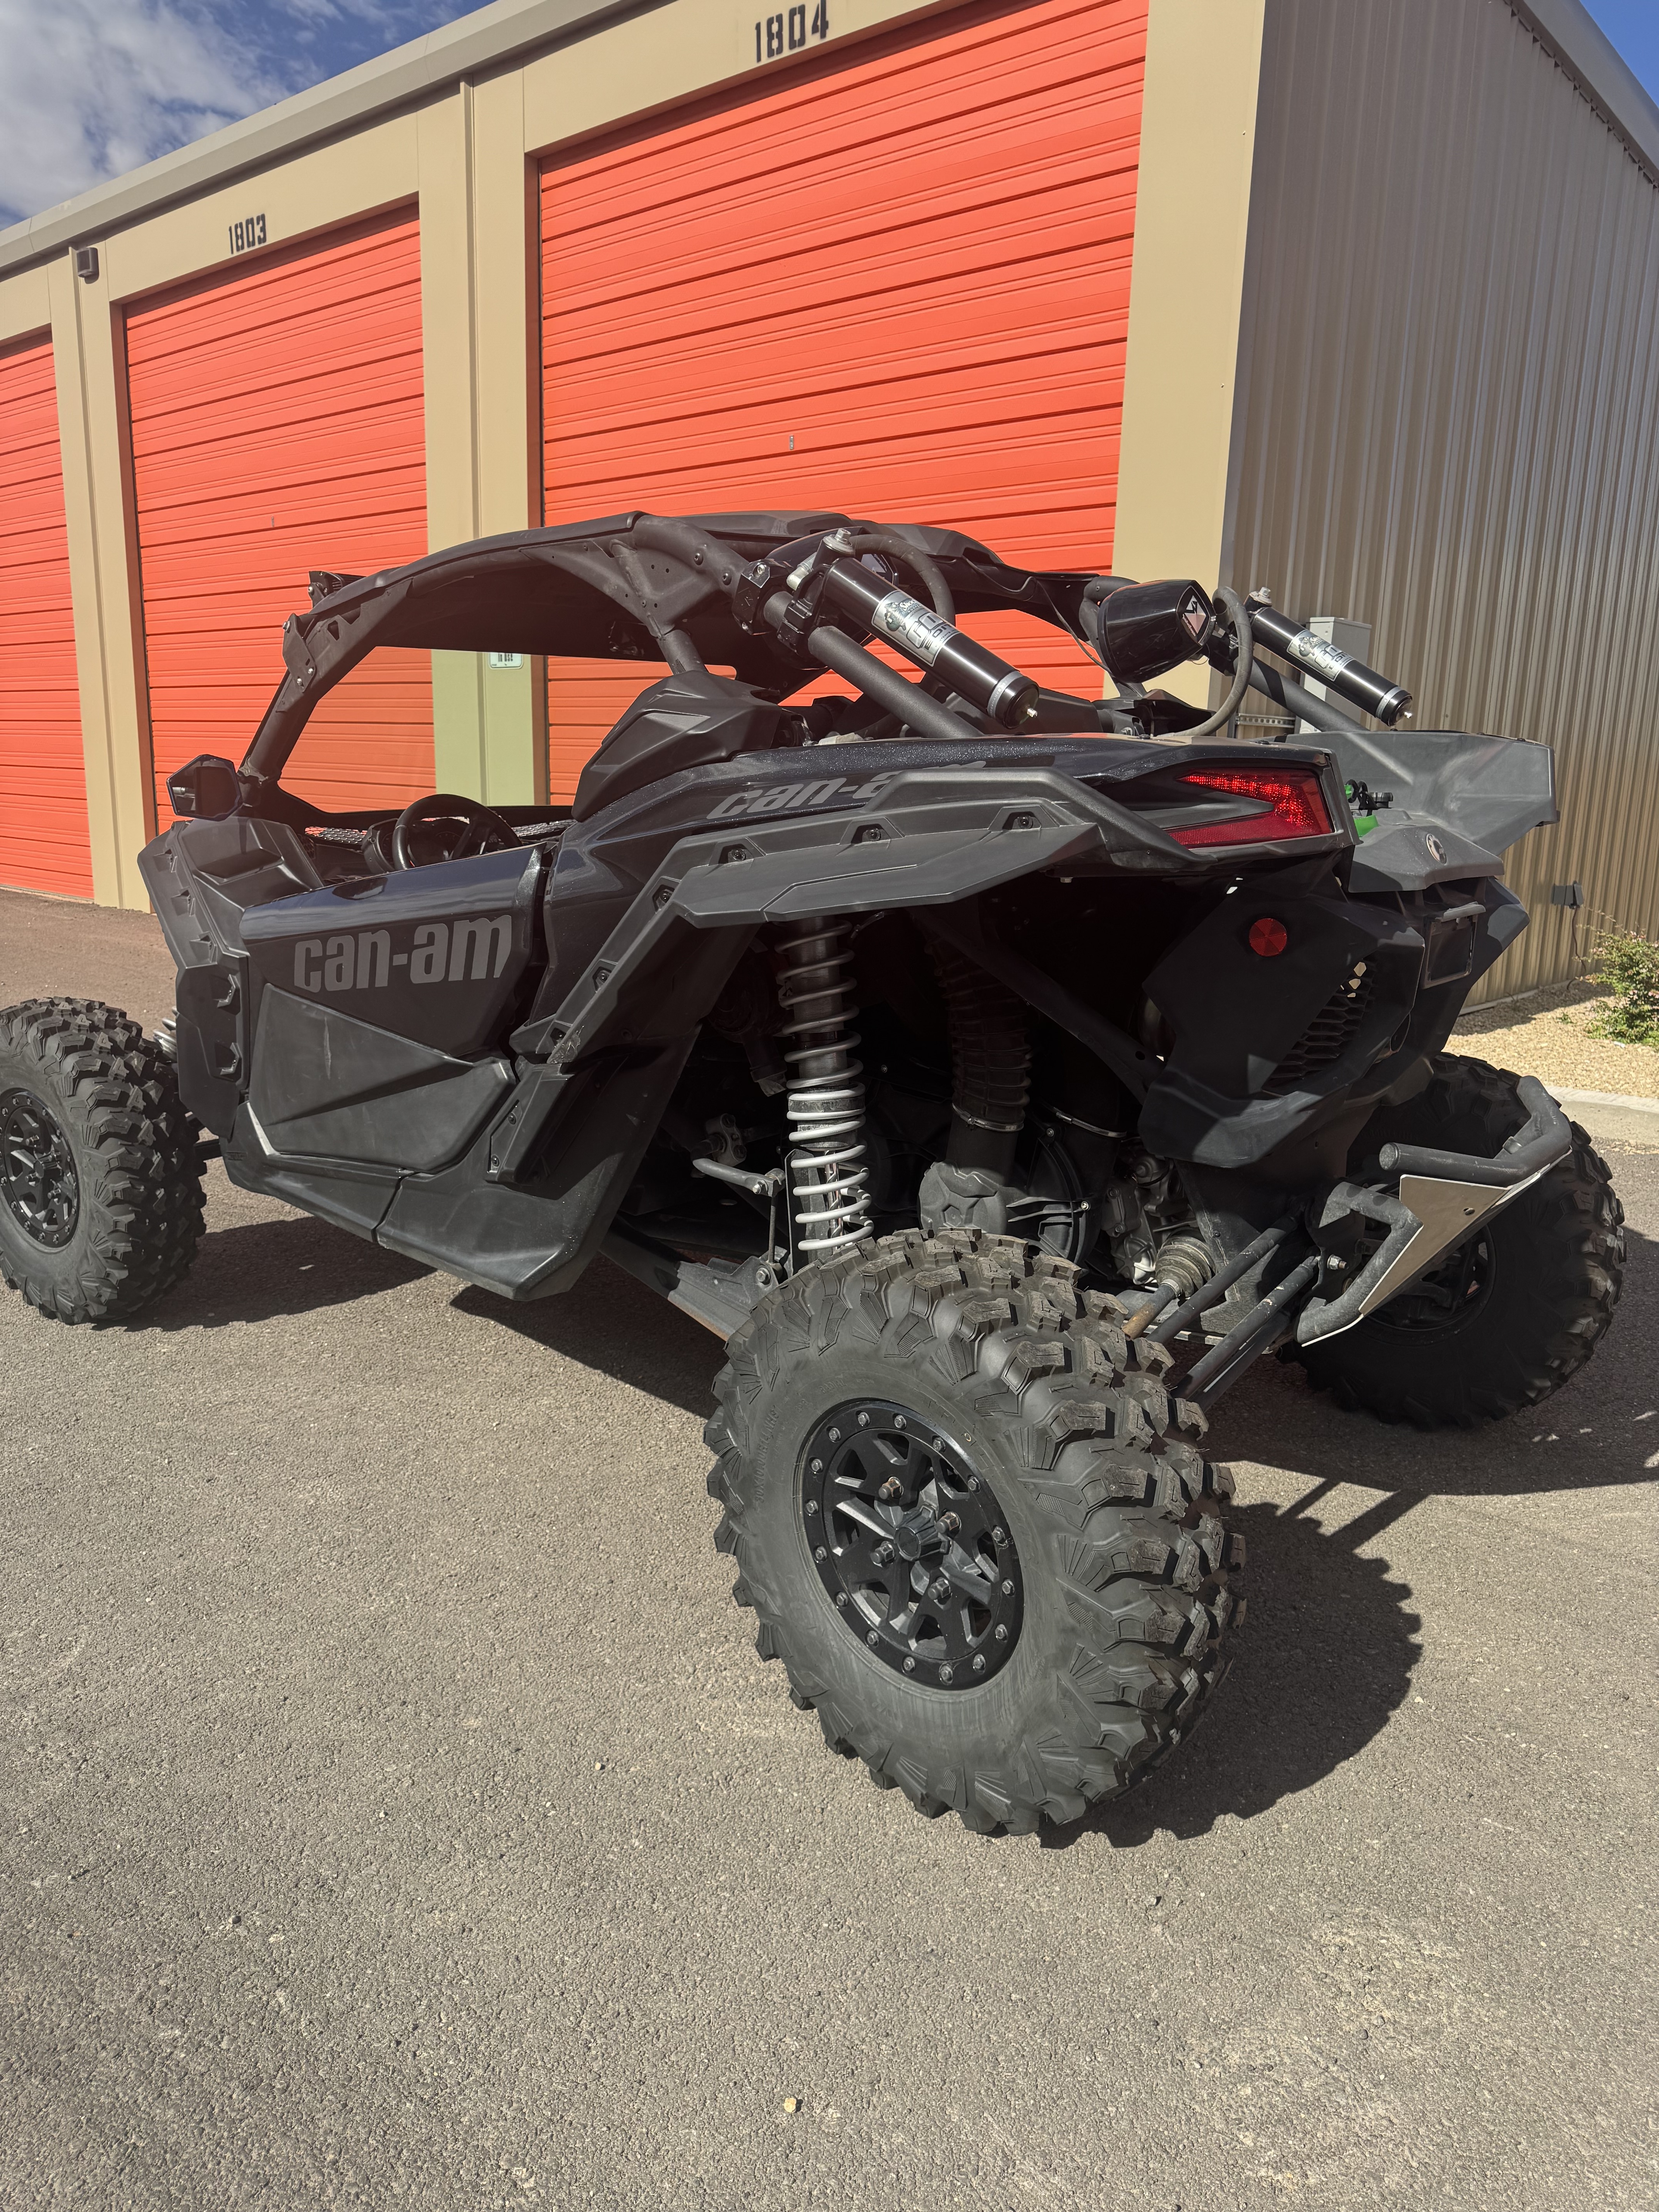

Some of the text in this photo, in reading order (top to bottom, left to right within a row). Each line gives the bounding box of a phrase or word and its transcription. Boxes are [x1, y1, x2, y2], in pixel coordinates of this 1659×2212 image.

[755, 0, 828, 63] 1804
[229, 213, 266, 254] 1803
[706, 771, 904, 819] can-a
[294, 915, 512, 993] can-am
